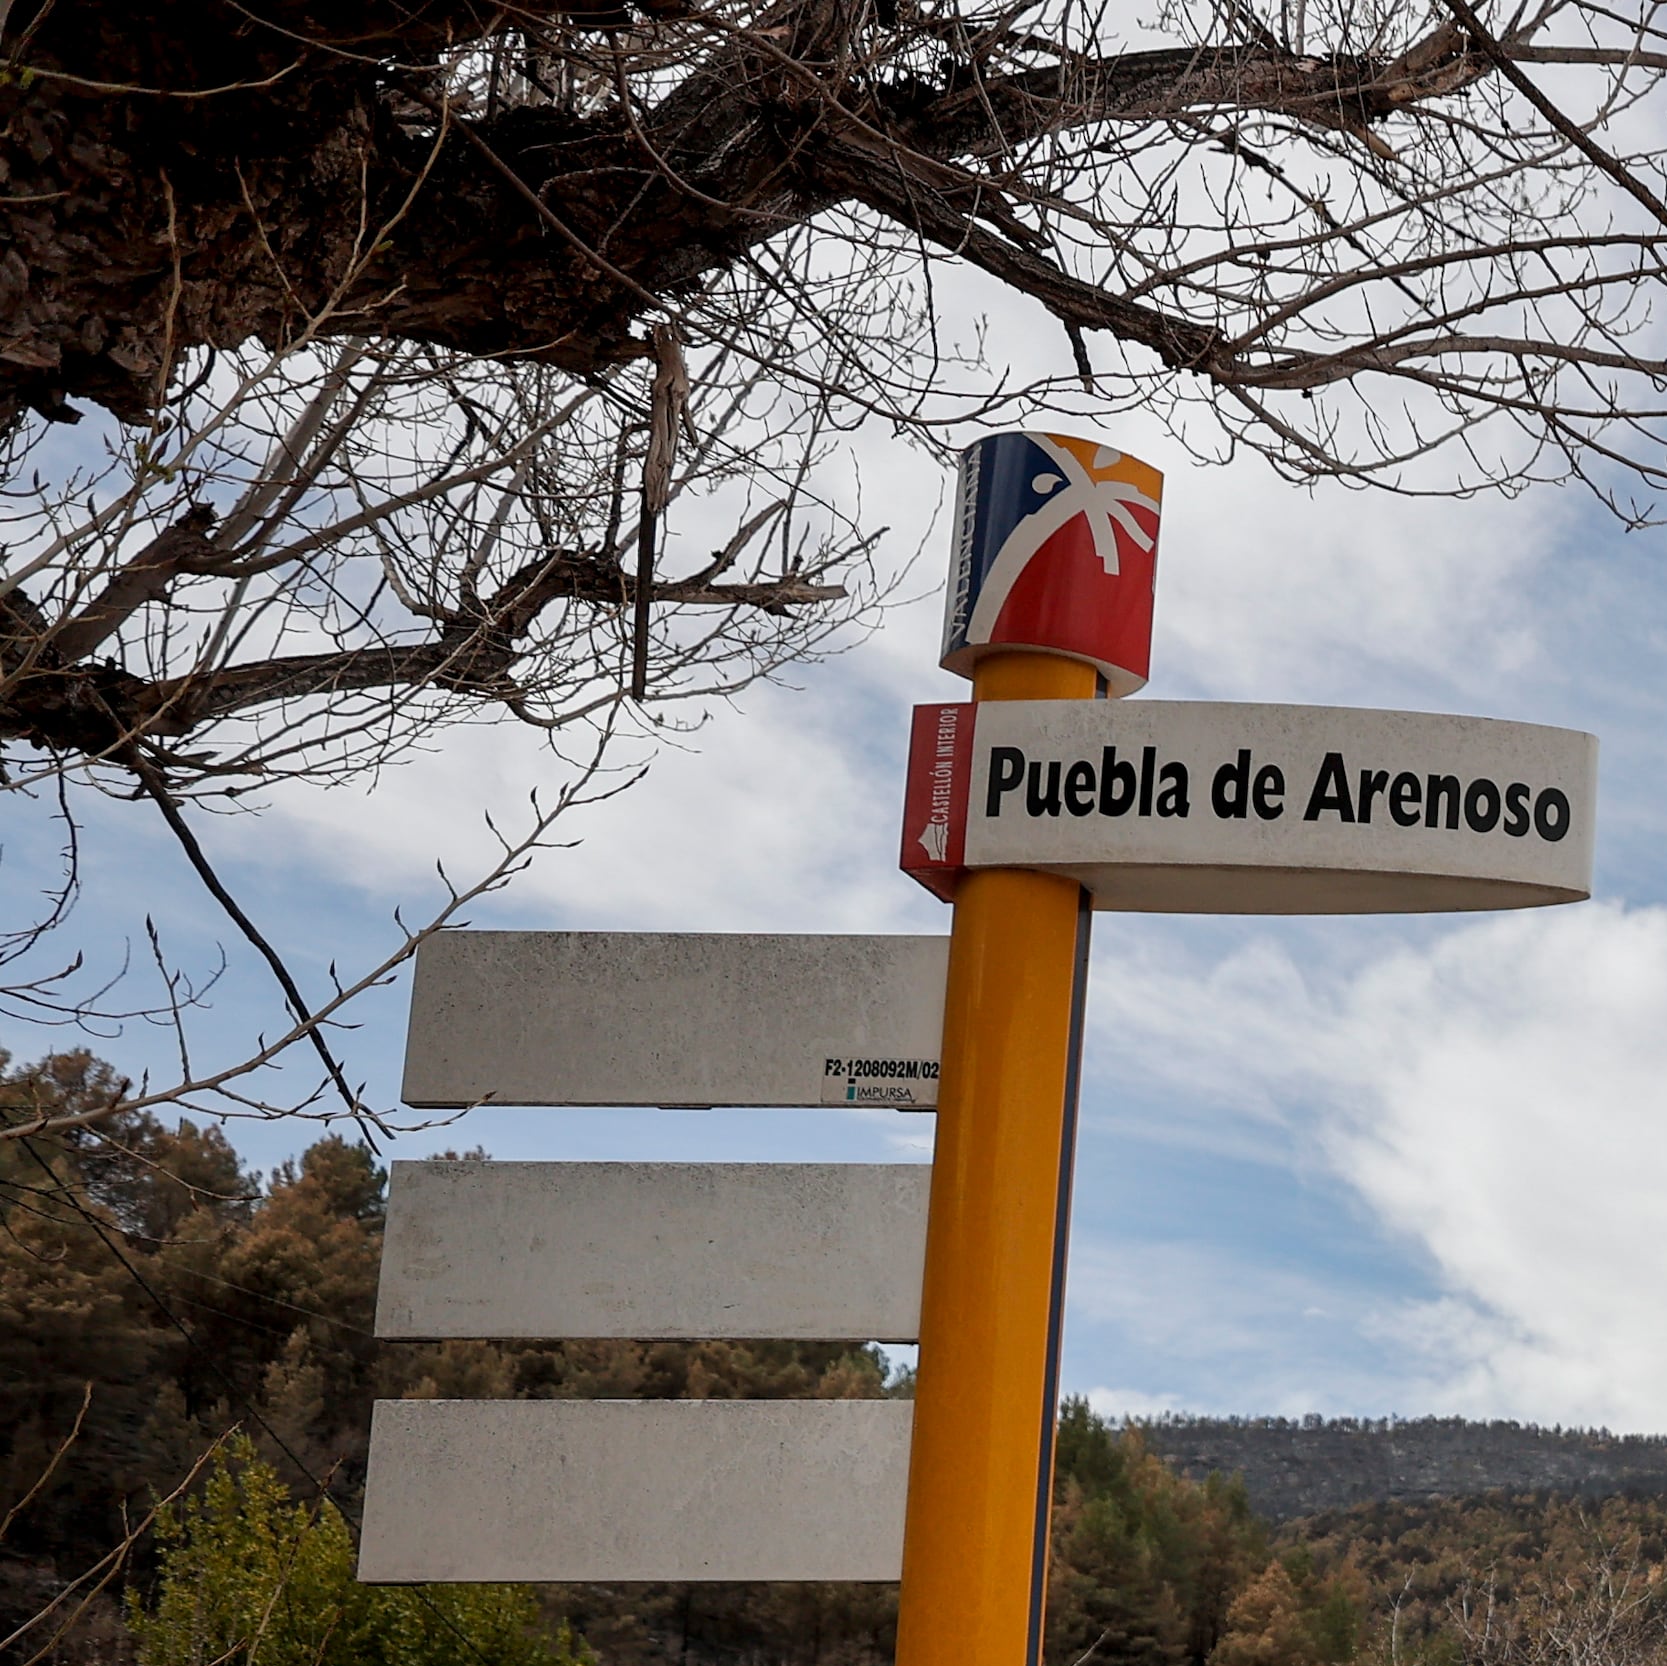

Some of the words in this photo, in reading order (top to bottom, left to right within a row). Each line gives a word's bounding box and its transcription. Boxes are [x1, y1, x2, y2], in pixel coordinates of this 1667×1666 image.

[936, 708, 959, 757] INTERIOR
[929, 761, 953, 823] CASTELLÓN
[986, 745, 1190, 819] Puebla
[1210, 748, 1285, 820] de
[1303, 751, 1571, 842] Arenoso
[858, 1086, 912, 1099] IMPURSA
